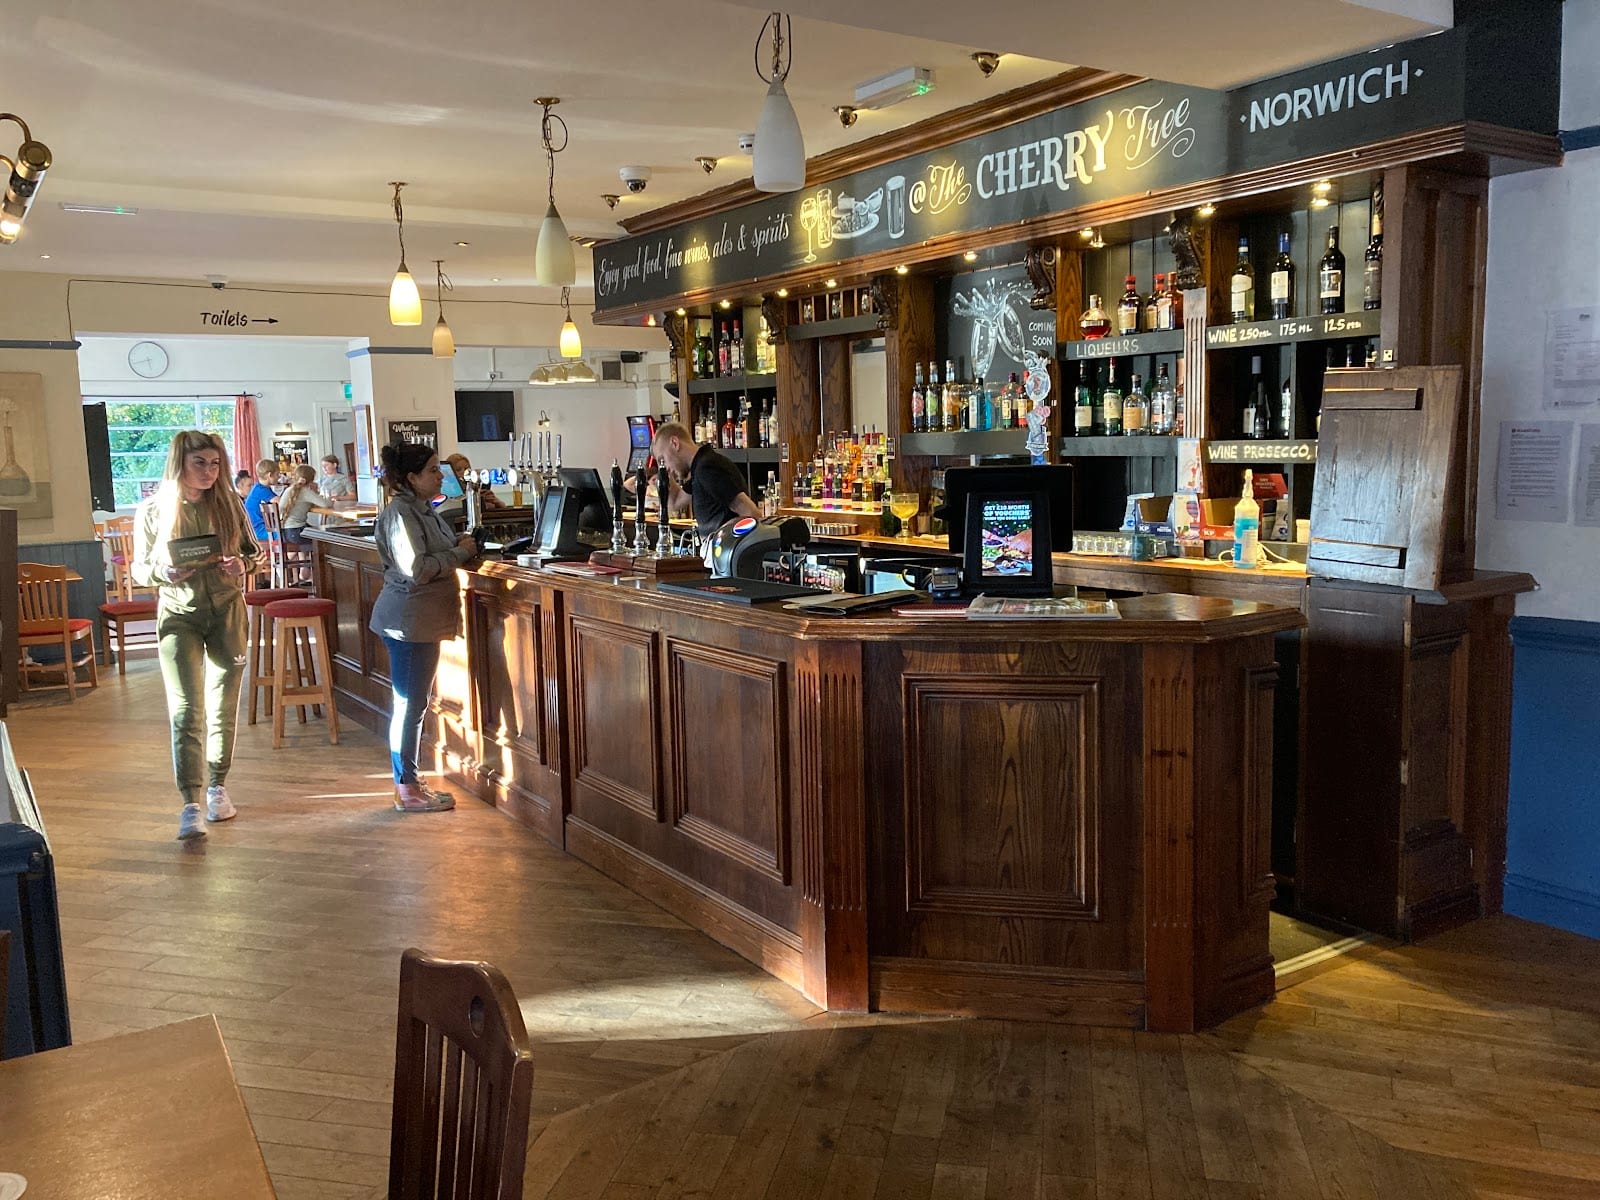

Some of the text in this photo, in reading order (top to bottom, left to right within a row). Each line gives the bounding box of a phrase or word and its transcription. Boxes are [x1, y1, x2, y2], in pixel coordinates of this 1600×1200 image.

[1249, 59, 1409, 133] NORWICH
[976, 110, 1114, 200] CHERRY
[1119, 98, 1196, 171] Tree
[598, 258, 620, 297] Enjoy
[622, 246, 642, 292] good
[664, 238, 683, 280] fine
[712, 222, 733, 259] ales
[738, 223, 747, 252] &
[751, 212, 793, 257] spirits
[200, 309, 248, 327] Toilets
[1032, 335, 1053, 346] SOON
[1208, 327, 1238, 344] WINE
[1076, 338, 1139, 359] LIQUEURS
[1207, 445, 1238, 460] WINE
